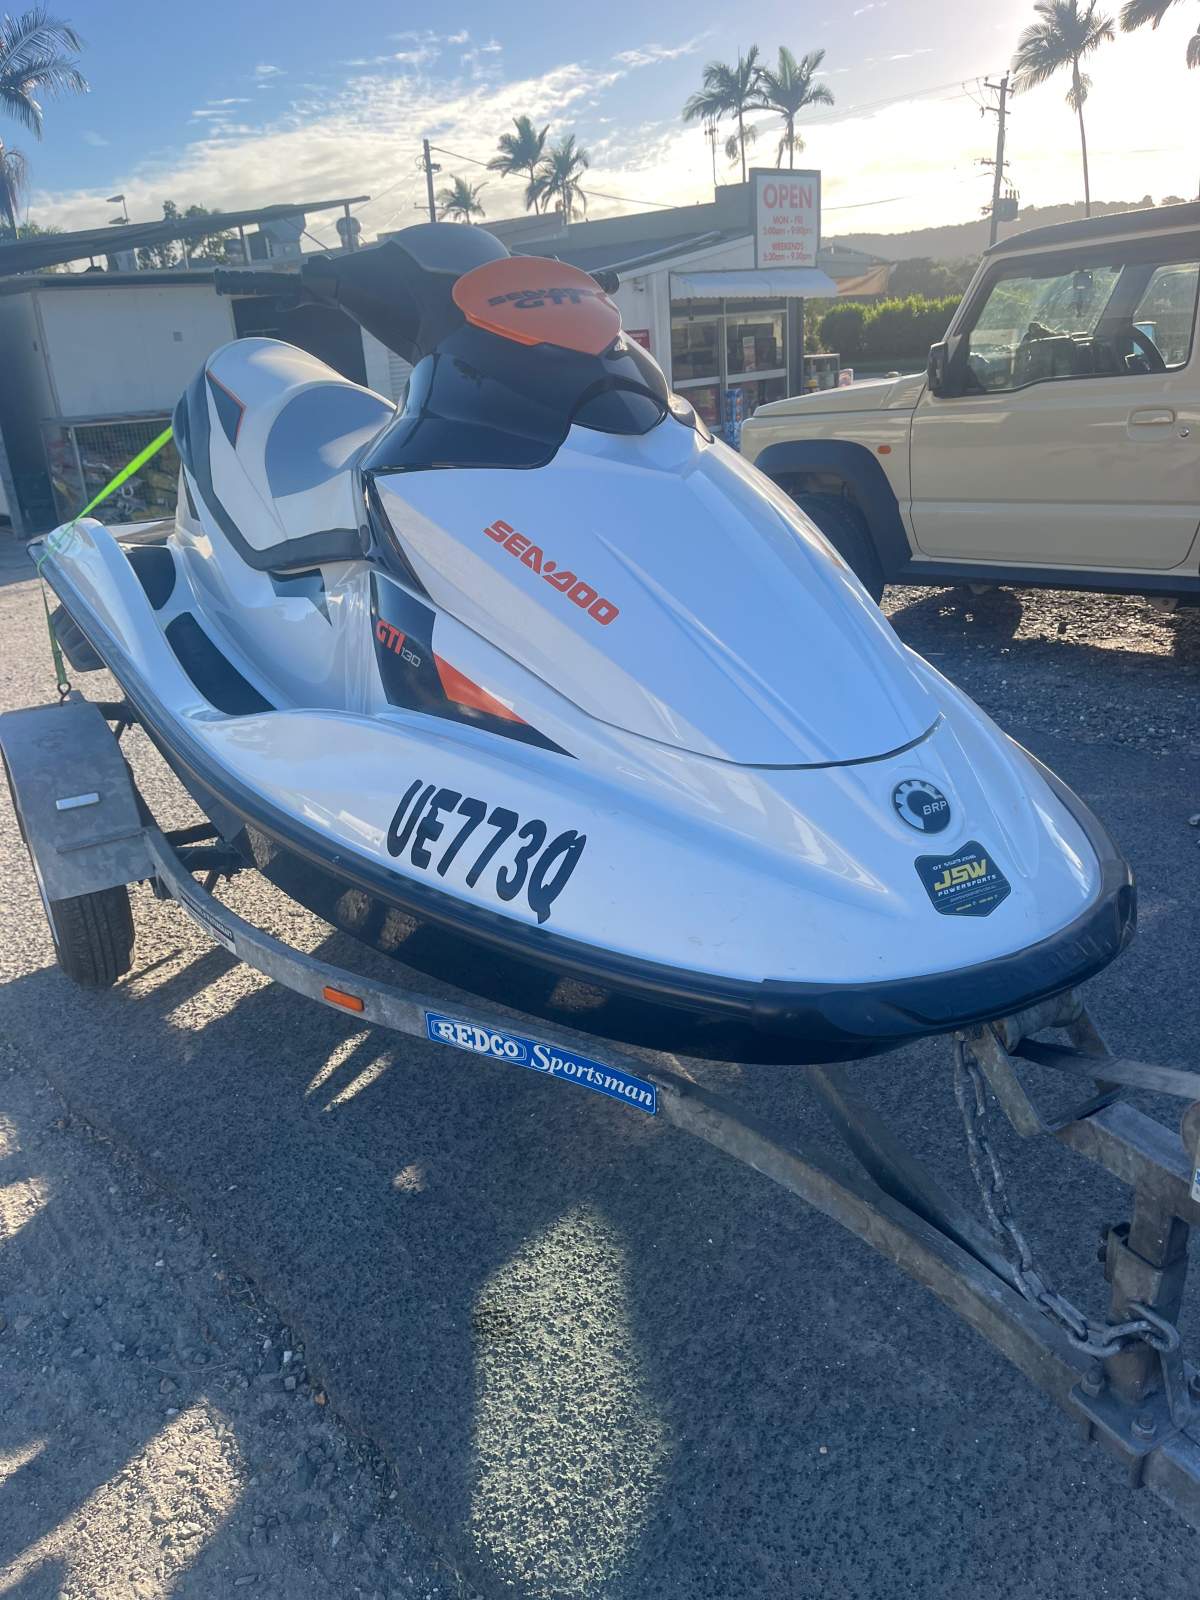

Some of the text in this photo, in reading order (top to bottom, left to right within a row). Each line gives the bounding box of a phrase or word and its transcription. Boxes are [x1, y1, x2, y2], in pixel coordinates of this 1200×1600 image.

[763, 184, 812, 208] OPEN
[773, 216, 789, 225] MON
[376, 619, 421, 668] GTI 130
[922, 800, 947, 815] BRP
[387, 779, 587, 924] UE773Q
[934, 859, 987, 891] JSW
[938, 874, 997, 897] POWERSPORTS
[530, 1044, 653, 1106] Sportsman
